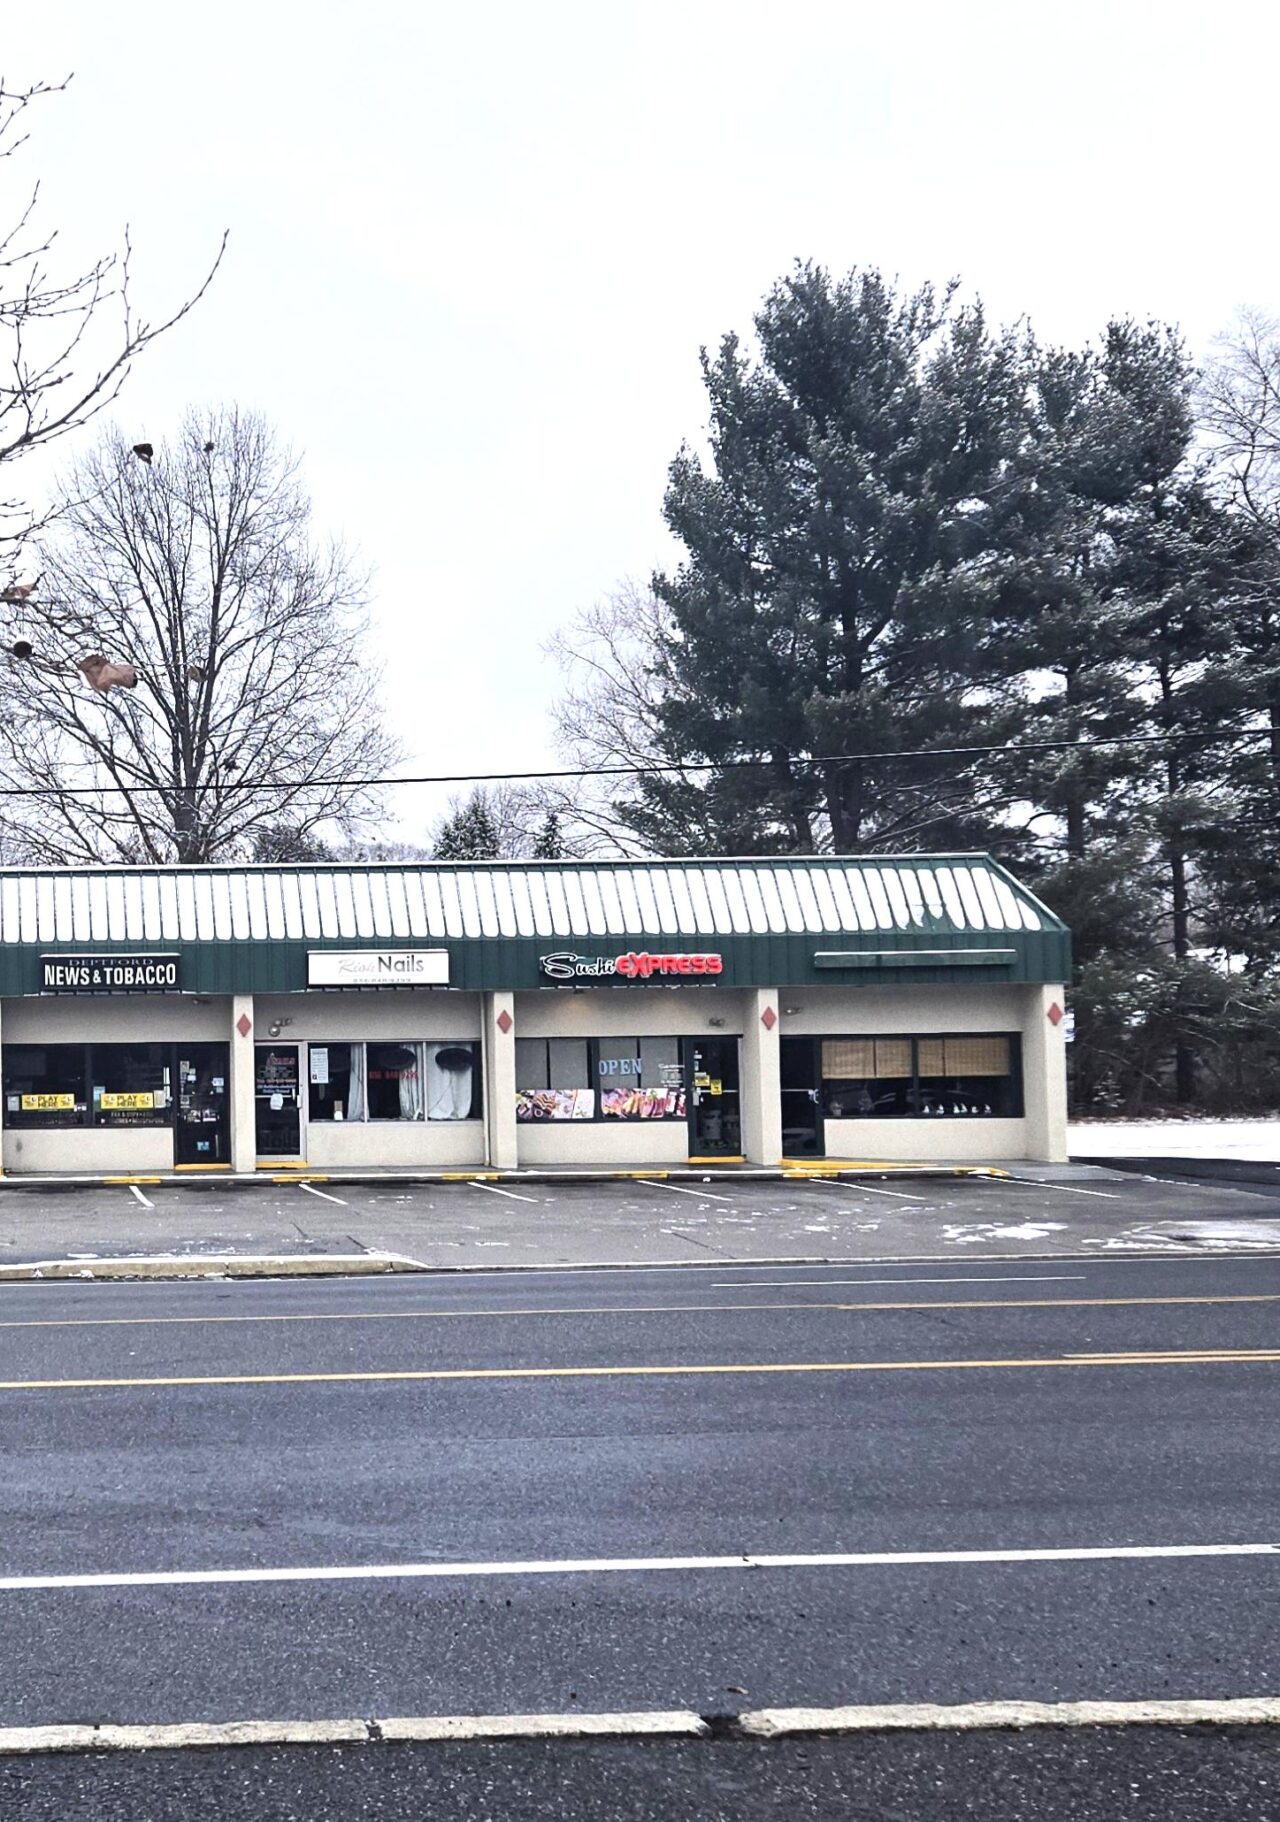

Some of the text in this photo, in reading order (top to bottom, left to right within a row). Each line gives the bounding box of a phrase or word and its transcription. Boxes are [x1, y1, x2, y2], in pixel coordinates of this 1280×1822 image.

[377, 954, 425, 973] Nails
[543, 952, 616, 978] Sushi
[44, 963, 176, 986] NEWS & TOBACCO
[599, 1058, 642, 1076] OPEN
